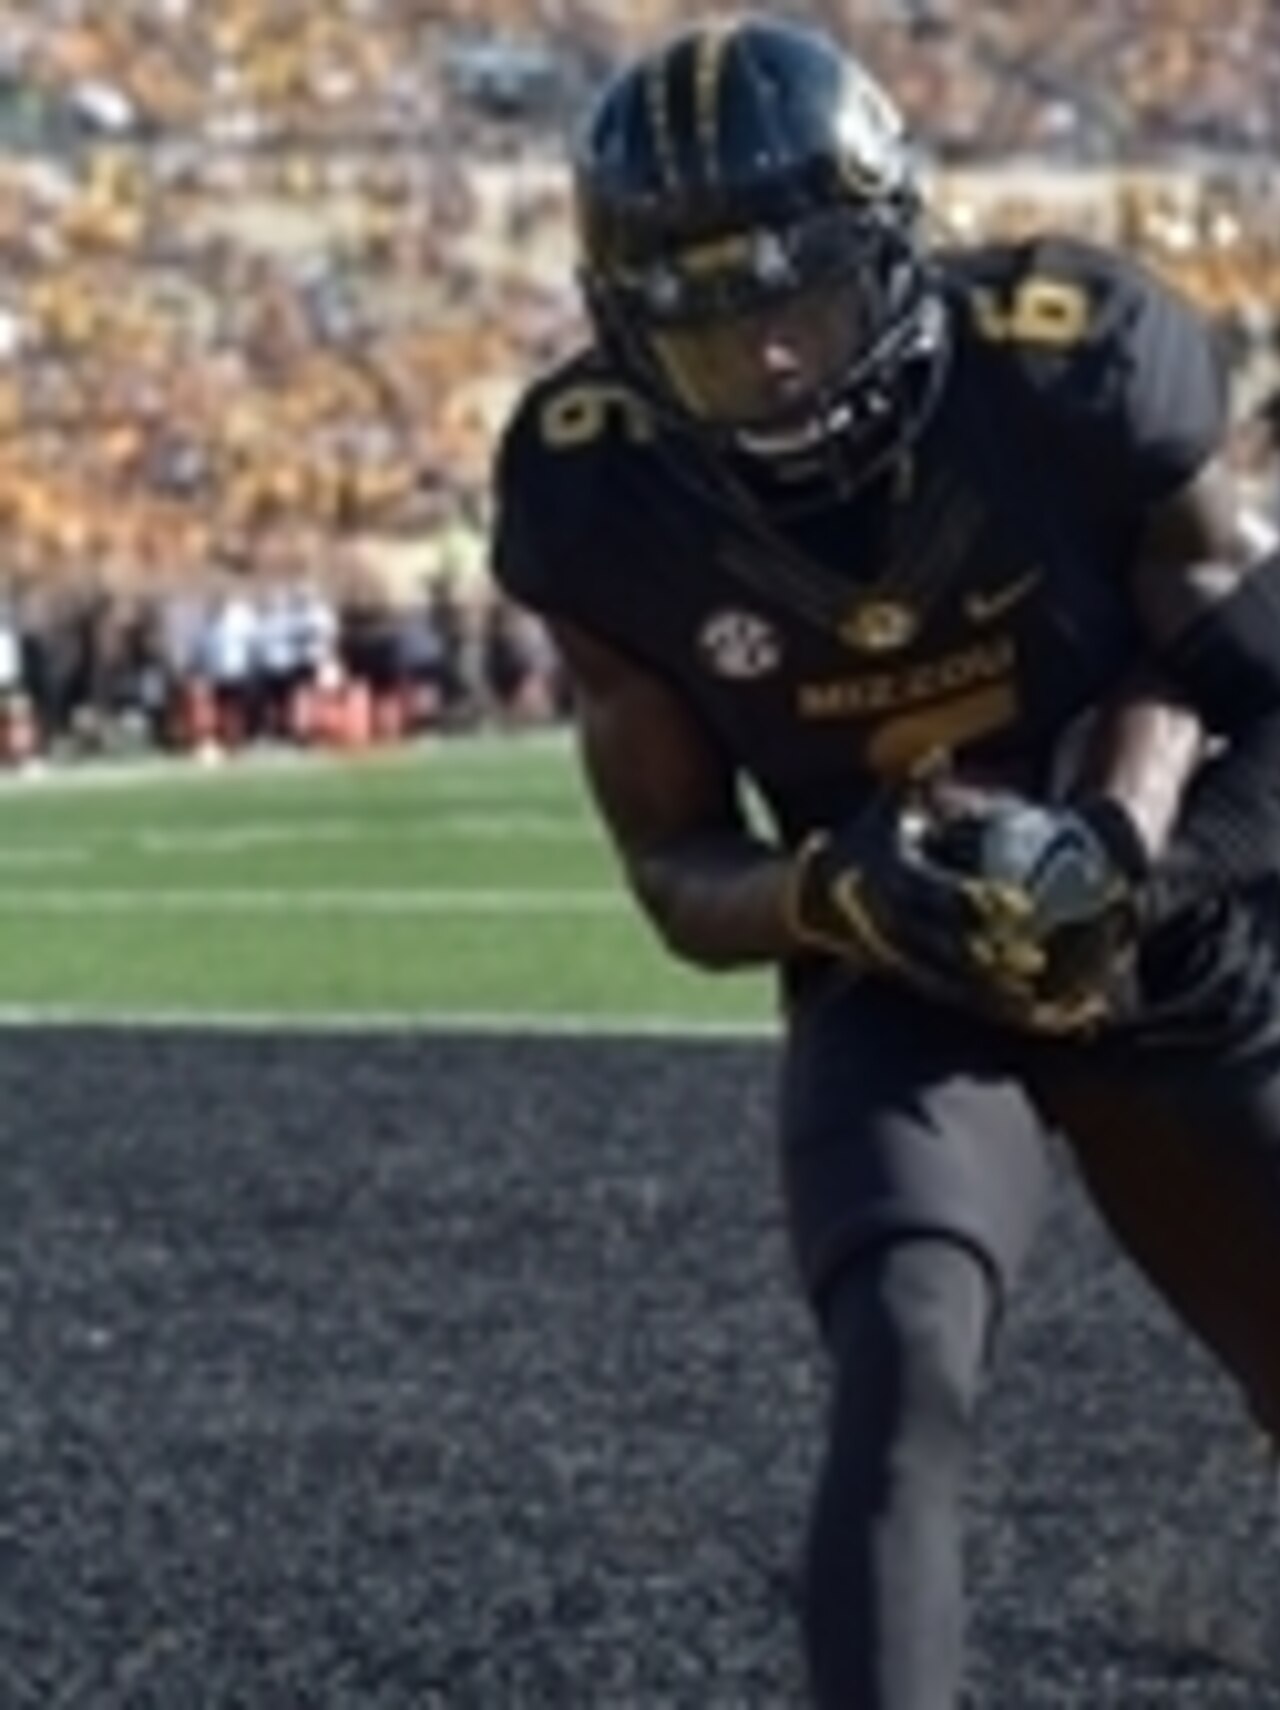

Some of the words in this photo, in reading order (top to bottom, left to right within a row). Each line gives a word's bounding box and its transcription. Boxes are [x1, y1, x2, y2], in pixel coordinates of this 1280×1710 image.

[969, 277, 1091, 347] 6
[542, 384, 656, 449] 6
[797, 635, 1018, 718] MIZZOU
